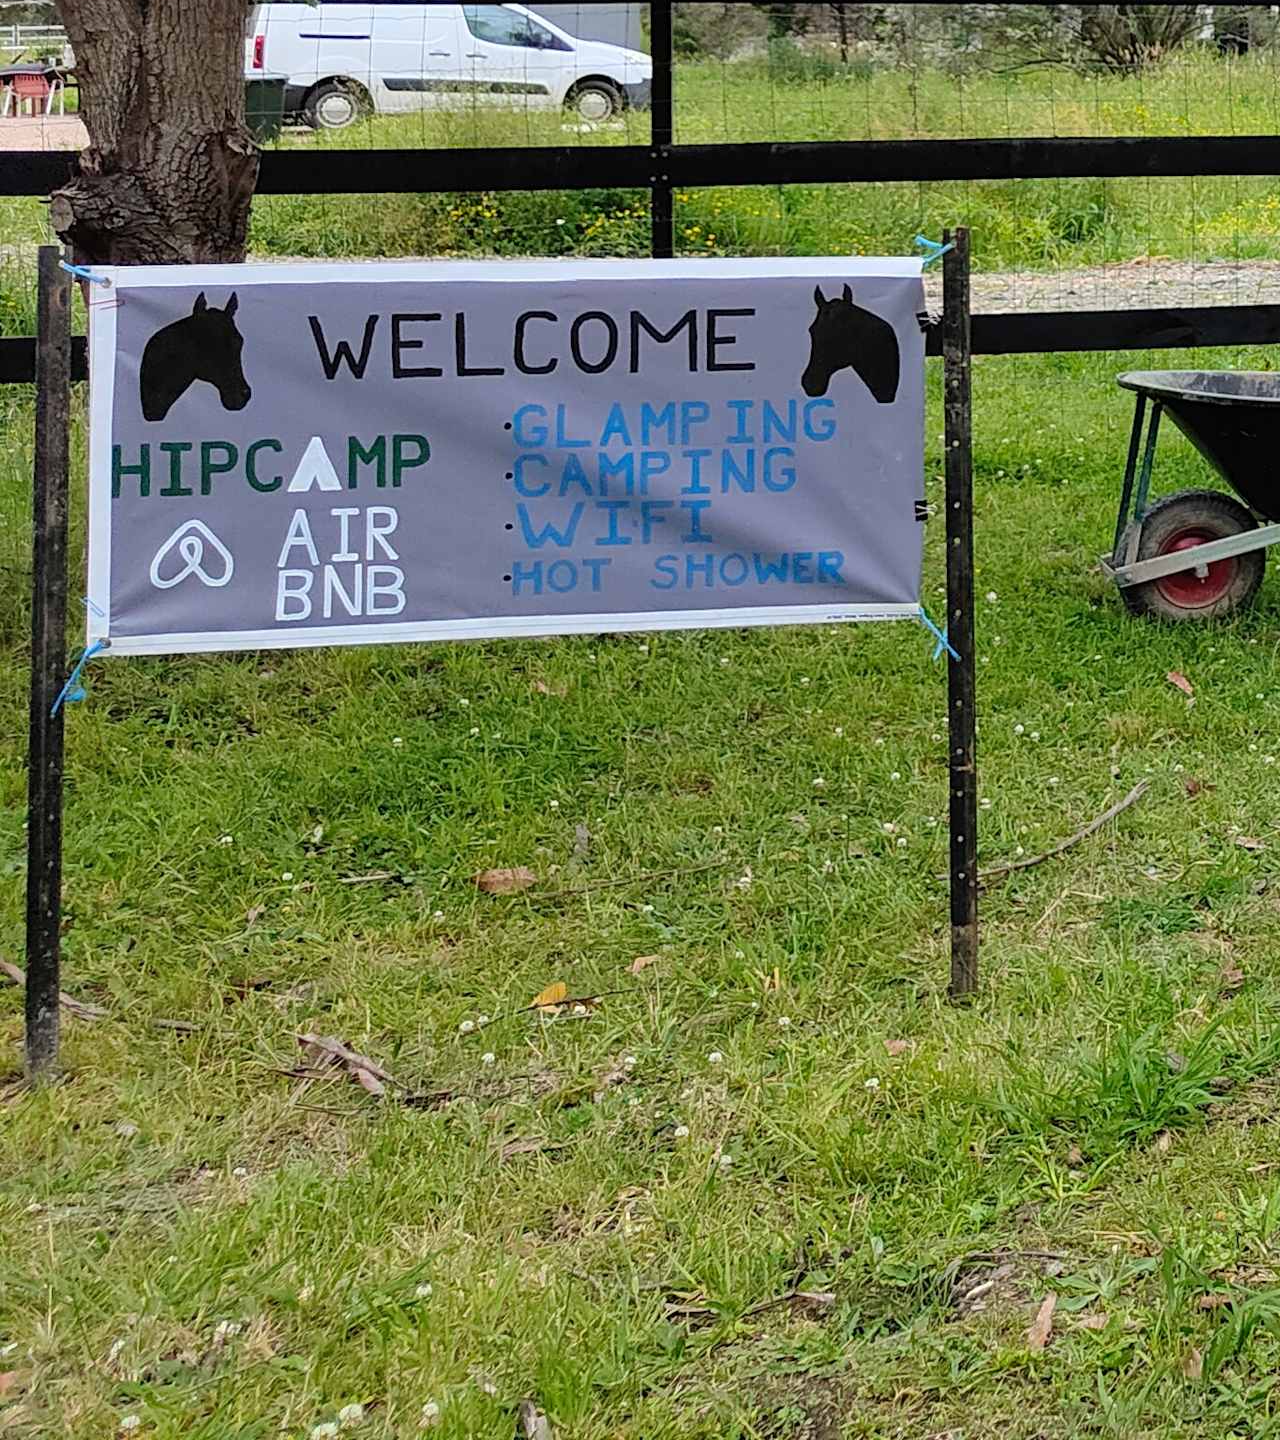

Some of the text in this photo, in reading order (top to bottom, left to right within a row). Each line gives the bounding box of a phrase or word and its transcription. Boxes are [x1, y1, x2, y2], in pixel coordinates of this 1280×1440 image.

[308, 308, 756, 380] WELCOME
[512, 398, 838, 448] GLAMPING
[111, 434, 431, 498] HIPCAMP
[513, 447, 797, 497] CAMPING
[277, 506, 400, 568] AIR
[516, 500, 713, 549] WIFI
[275, 563, 406, 622] BNB
[511, 551, 848, 596] HOT SHOWER
